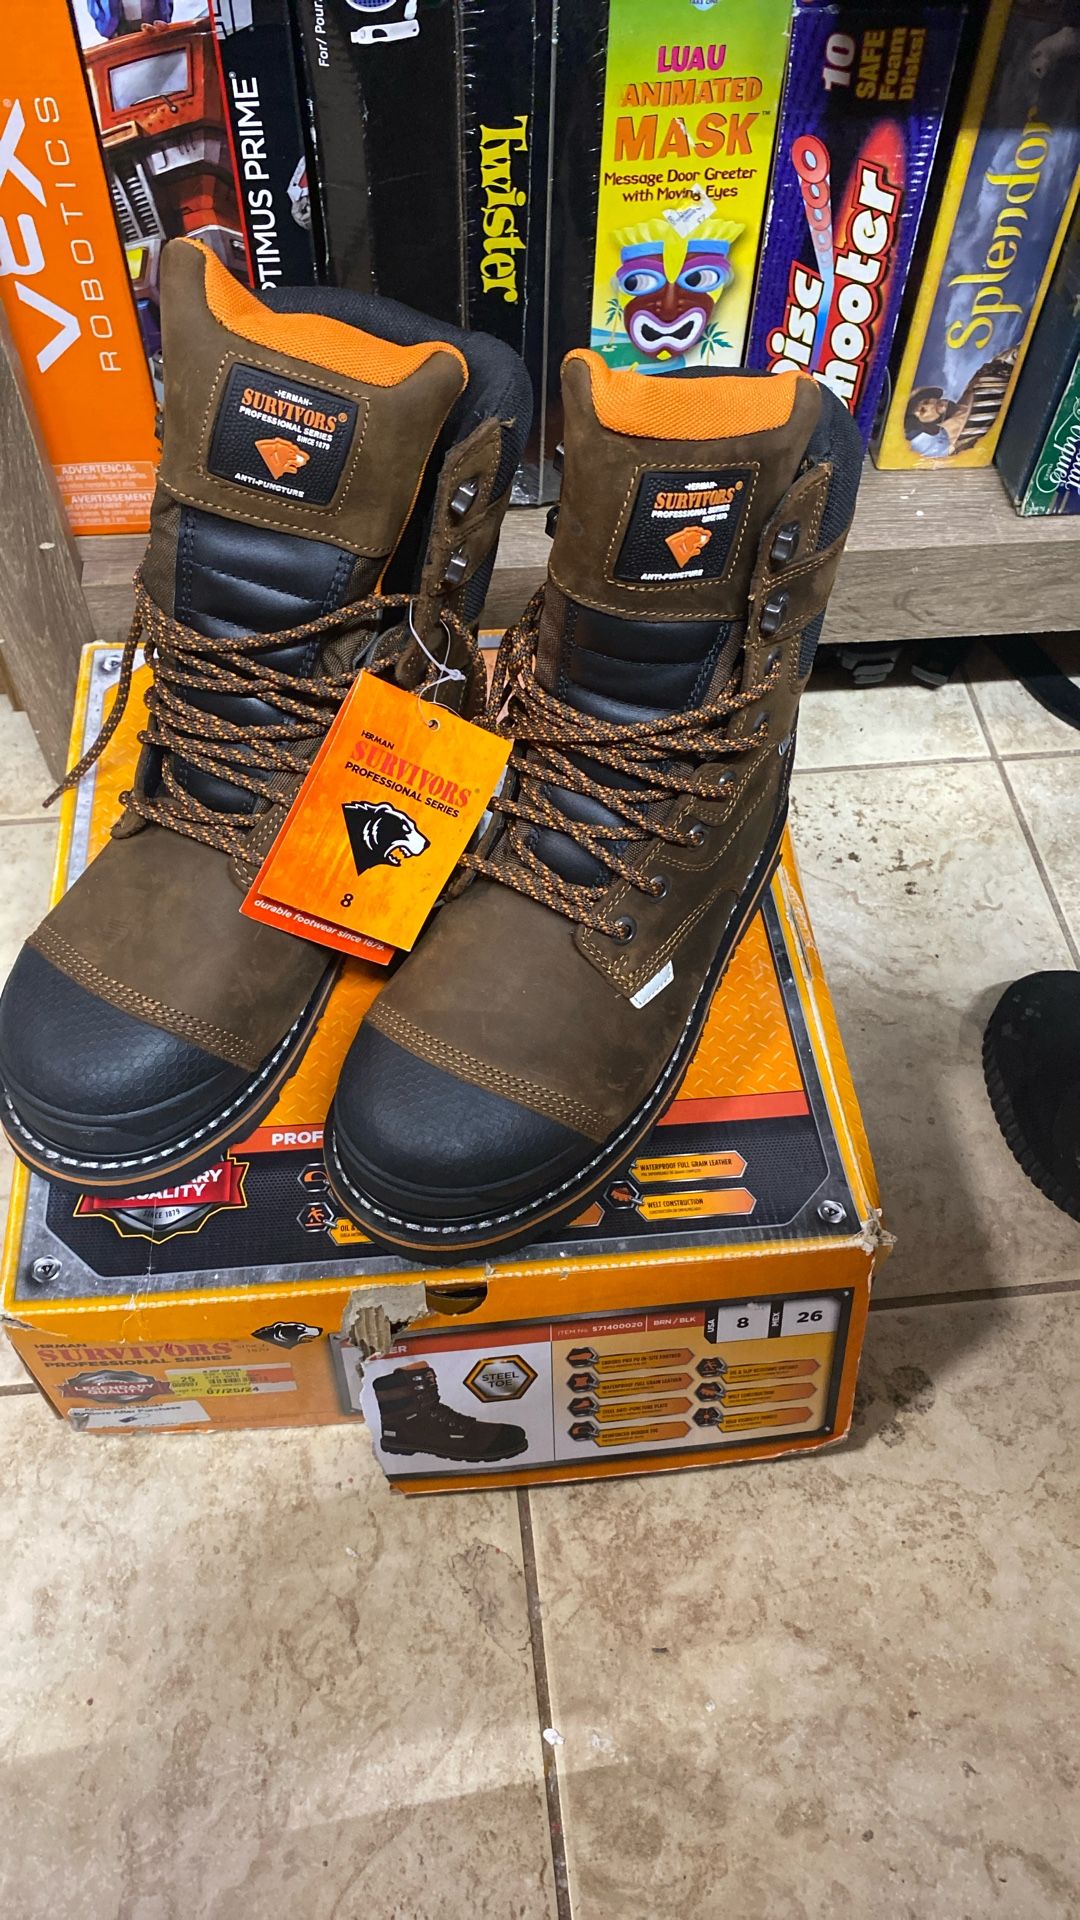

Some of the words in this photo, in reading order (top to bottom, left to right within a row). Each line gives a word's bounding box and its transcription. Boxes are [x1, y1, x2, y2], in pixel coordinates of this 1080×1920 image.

[315, 37, 330, 67] For/
[657, 44, 727, 73] LUAU
[822, 33, 857, 91] 10
[856, 29, 886, 99] SAFE
[878, 28, 907, 100] Foam
[898, 29, 927, 100] Disks!
[620, 76, 763, 107] ANIMATED
[231, 77, 270, 180] PRIME
[614, 112, 760, 161] MASK
[604, 172, 663, 186] Message
[667, 168, 700, 183] Door
[704, 167, 757, 179] Greeter
[622, 188, 653, 202] with
[657, 187, 701, 201] Moving
[706, 185, 738, 200] Eyes
[479, 115, 528, 302] Twister
[0, 99, 82, 374] VEX
[34, 96, 122, 372] ROBOTICS
[247, 188, 283, 290] TIMUS
[946, 104, 1052, 349] Splendor
[812, 168, 897, 409] hooter
[239, 405, 302, 434] PROFESSIONAL
[303, 426, 333, 442] SERIES
[241, 388, 337, 433] SURVIVORS
[61, 463, 136, 475] ADVERTENCIA:
[234, 472, 305, 498] ANTI-PUNCTURE
[653, 487, 736, 510] SURVIVORS
[651, 507, 708, 518] PROFESSIONAL
[360, 730, 395, 750] HERMAN
[349, 739, 472, 808] SURVIVORS
[344, 761, 422, 804] PROFESSIONAL
[424, 797, 460, 818] SERIES
[340, 893, 354, 908] 8
[254, 898, 292, 919] durable
[292, 911, 338, 936] footwear
[336, 927, 362, 944] since
[592, 1321, 643, 1332] 571400020
[707, 1318, 715, 1333] USA
[736, 1317, 750, 1328] 8
[771, 1312, 780, 1327] MEX
[796, 1310, 823, 1323] 26
[37, 1341, 233, 1363] SURVIVORS
[44, 1357, 170, 1368] PROFESSIONAL
[174, 1354, 232, 1363] SERIES
[74, 1383, 154, 1391] LEGENDARY
[482, 1371, 519, 1382] STEEL
[487, 1380, 513, 1388] TOE
